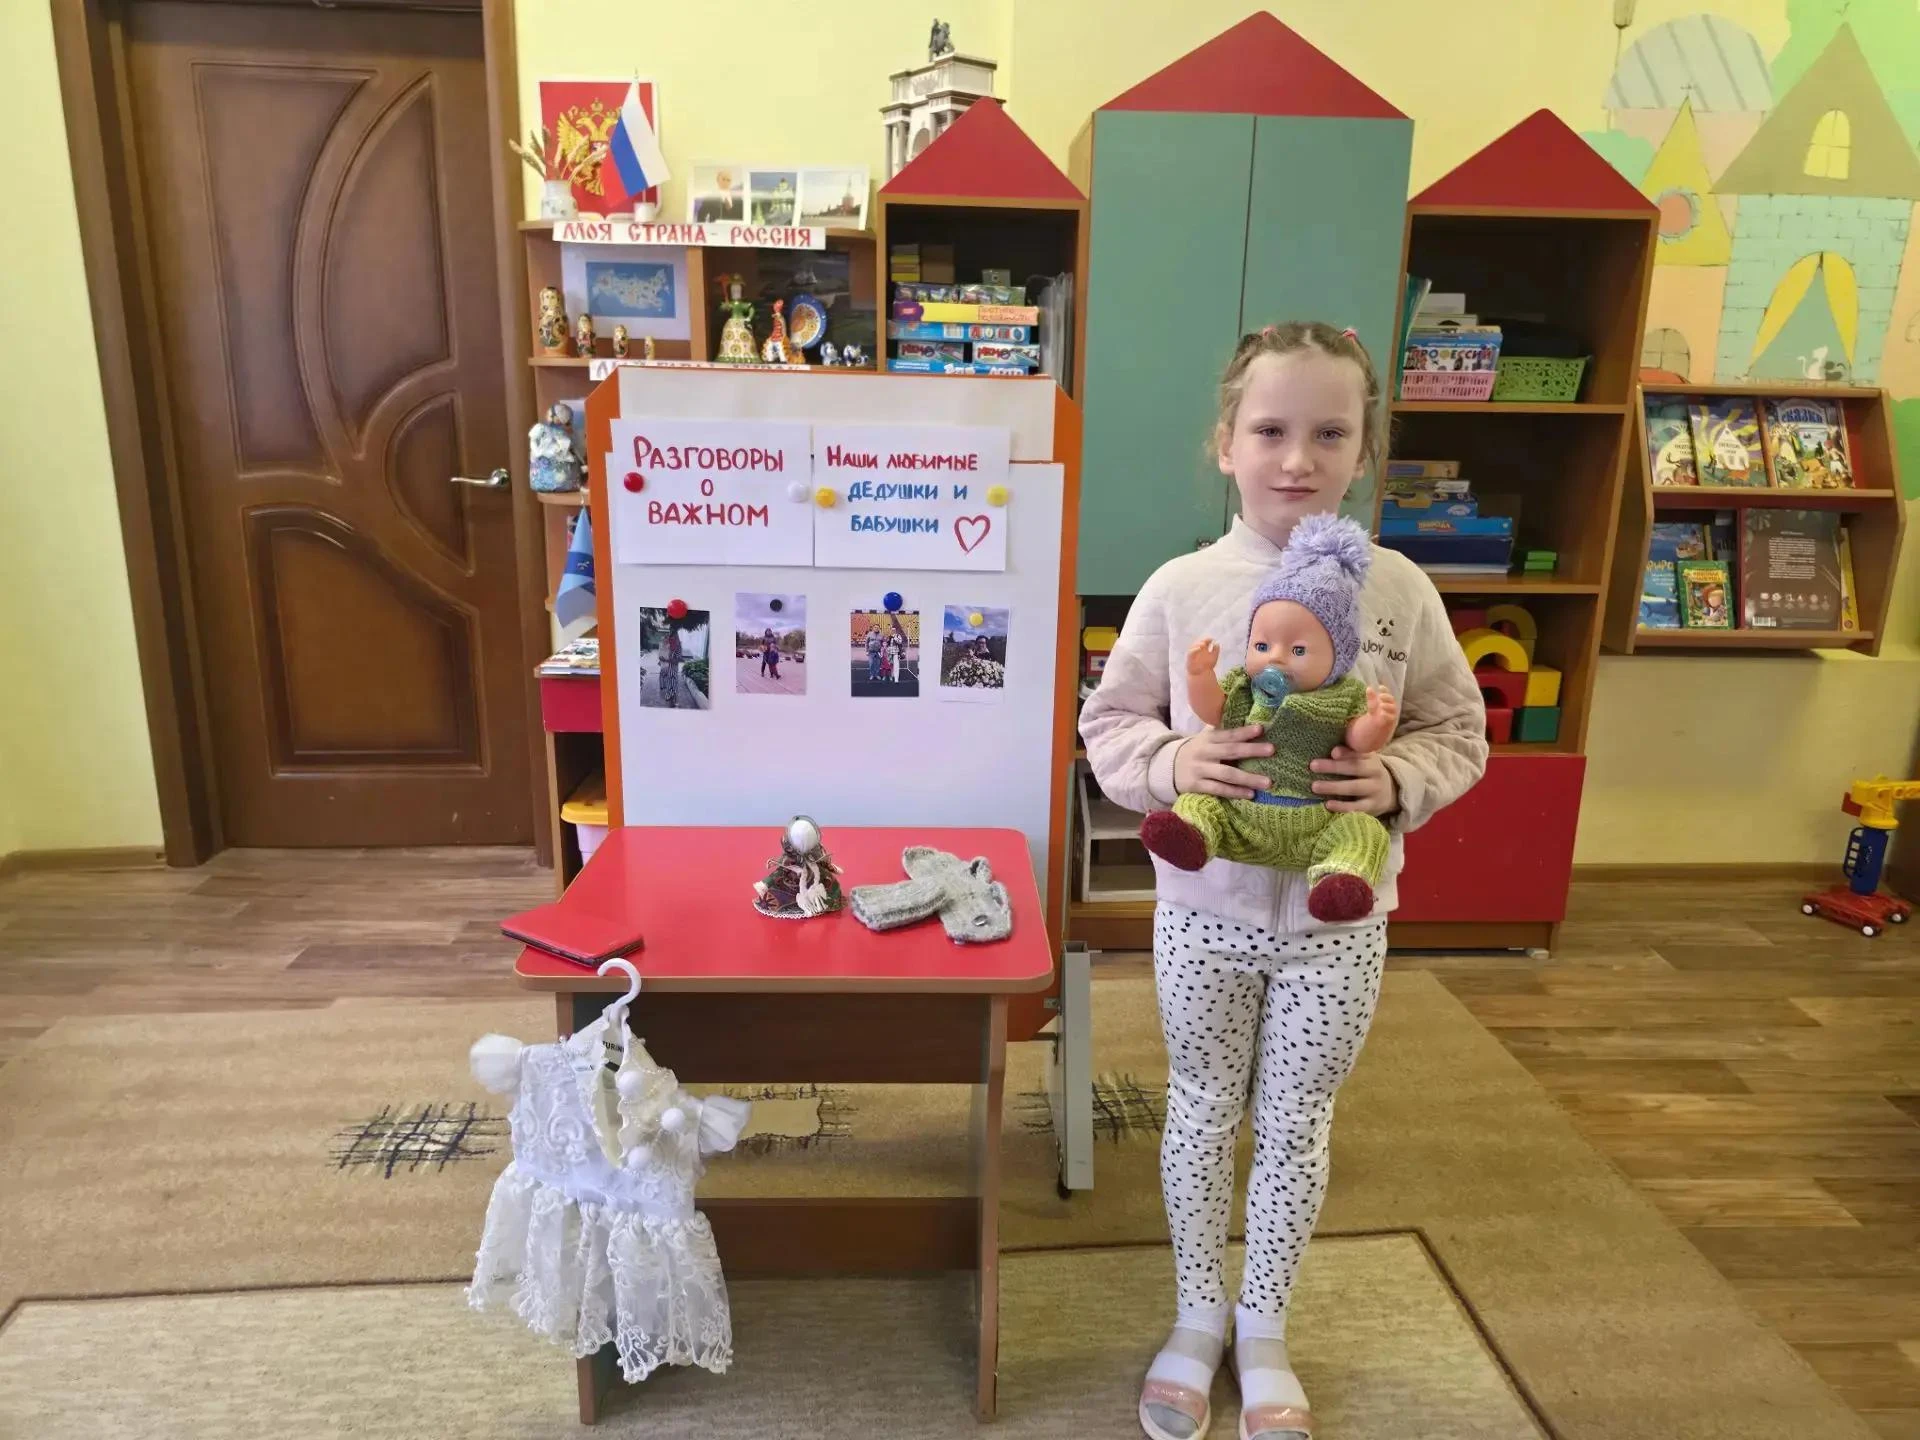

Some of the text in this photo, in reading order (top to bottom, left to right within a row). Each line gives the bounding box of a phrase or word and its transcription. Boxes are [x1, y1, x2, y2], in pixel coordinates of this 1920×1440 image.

[563, 222, 613, 241] МОЯ
[730, 226, 811, 247] РОССИЯ
[633, 435, 784, 473] РАЗГОВОРЫ
[826, 445, 978, 471] НАШИ ЛЮБИМЫЕ
[700, 478, 714, 497] О
[847, 480, 968, 502] ДЕДУШКИ И
[648, 502, 769, 528] ВАЖНОМ
[850, 514, 939, 534] БАБУШКИ
[1387, 649, 1407, 663] NO
